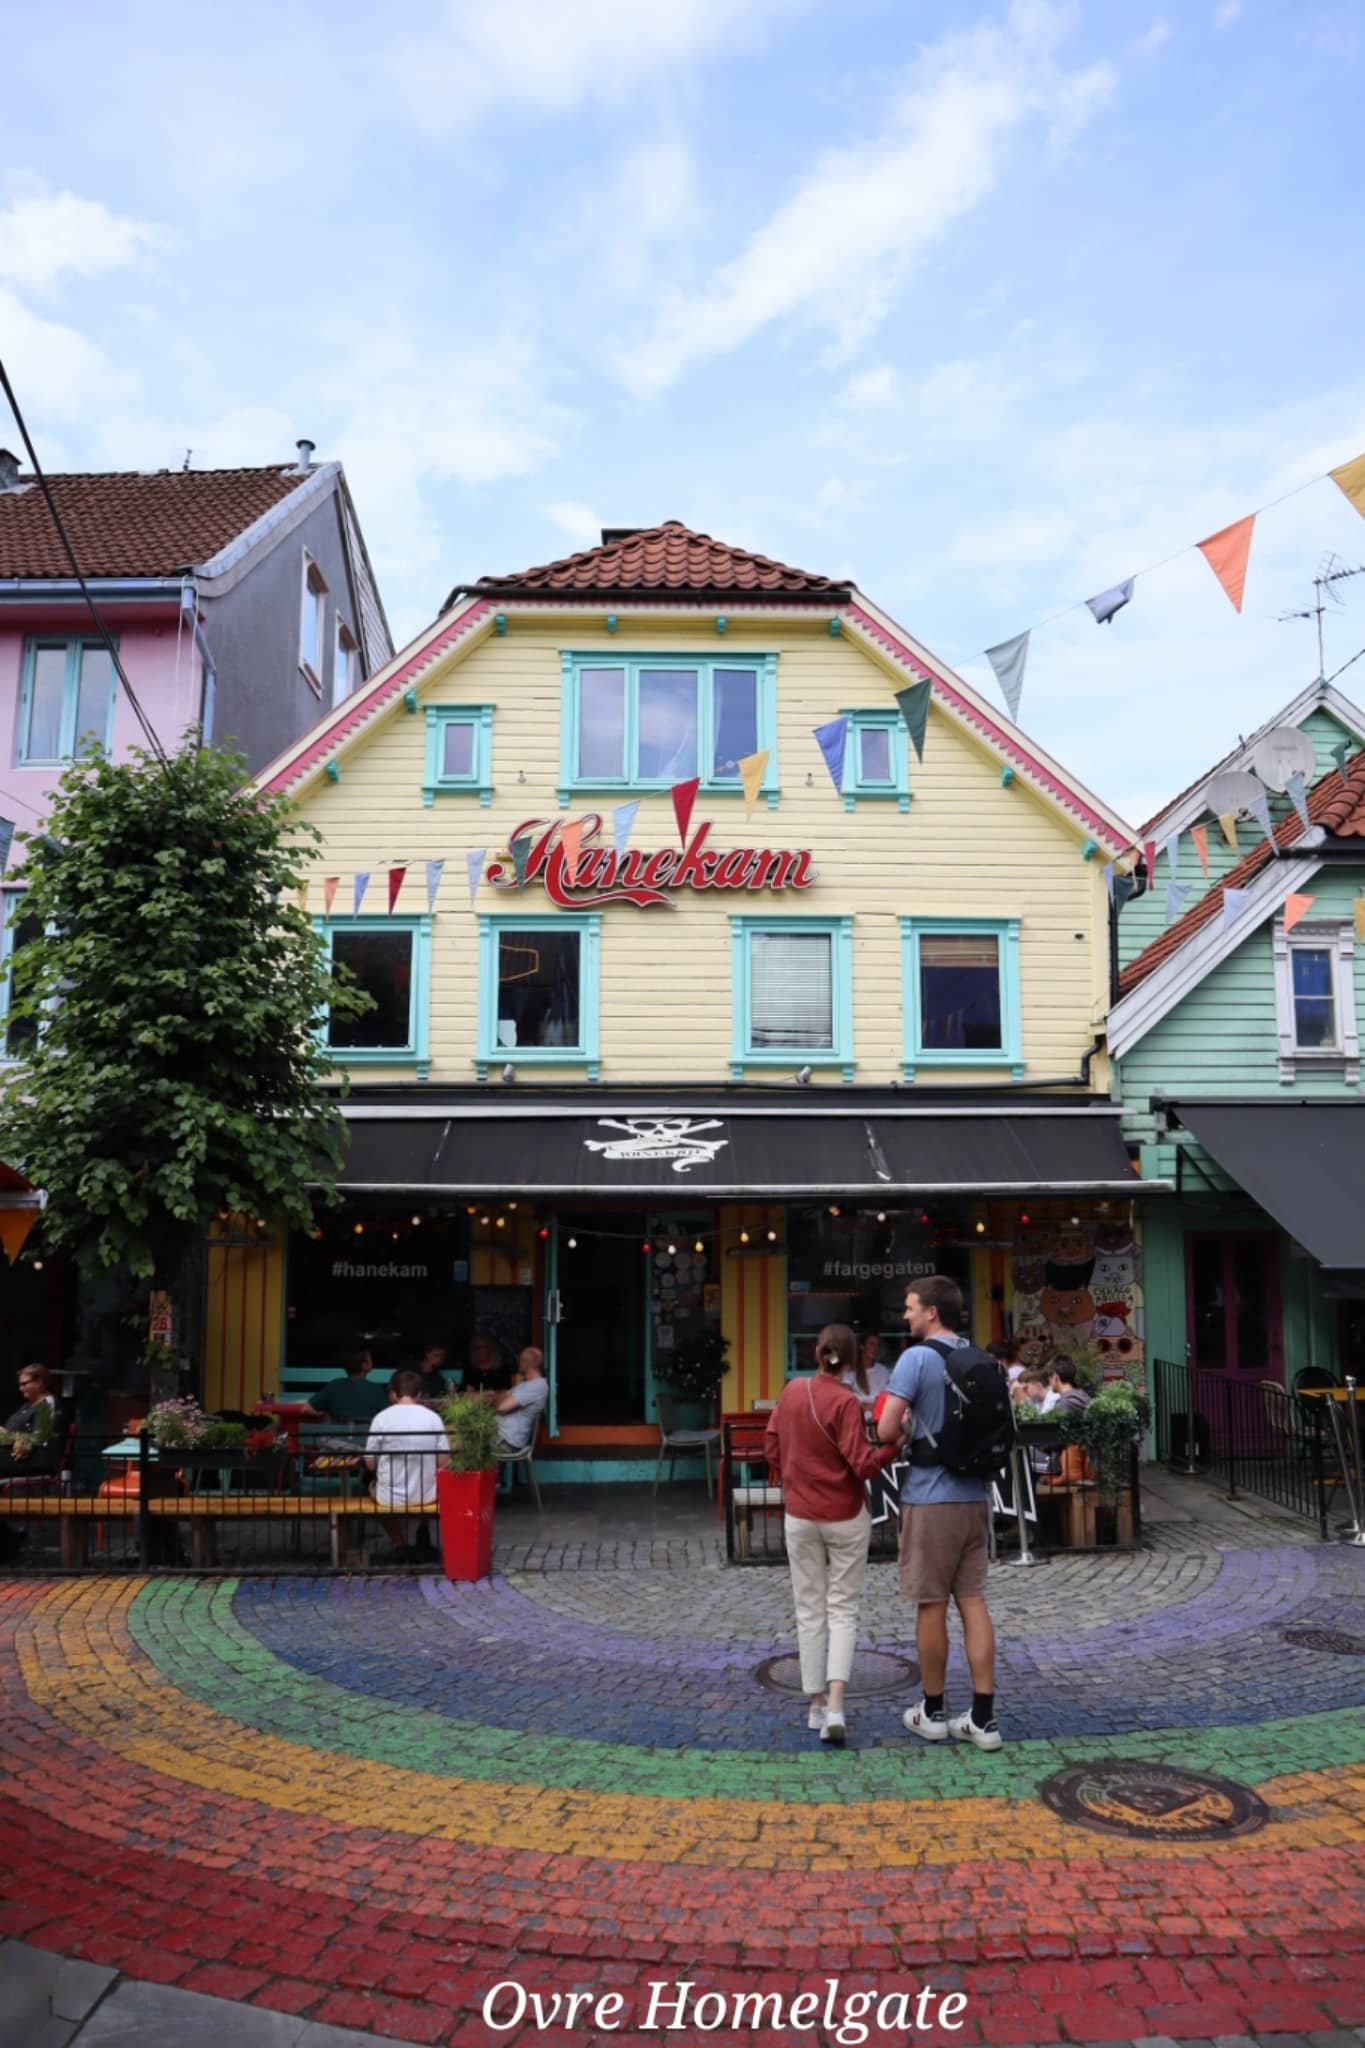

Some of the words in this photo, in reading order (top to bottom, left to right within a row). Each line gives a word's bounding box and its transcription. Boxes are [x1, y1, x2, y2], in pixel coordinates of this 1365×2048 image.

[486, 813, 819, 908] Hanekam
[332, 1261, 427, 1277] #hanekam
[823, 1260, 936, 1281] #fargegaten
